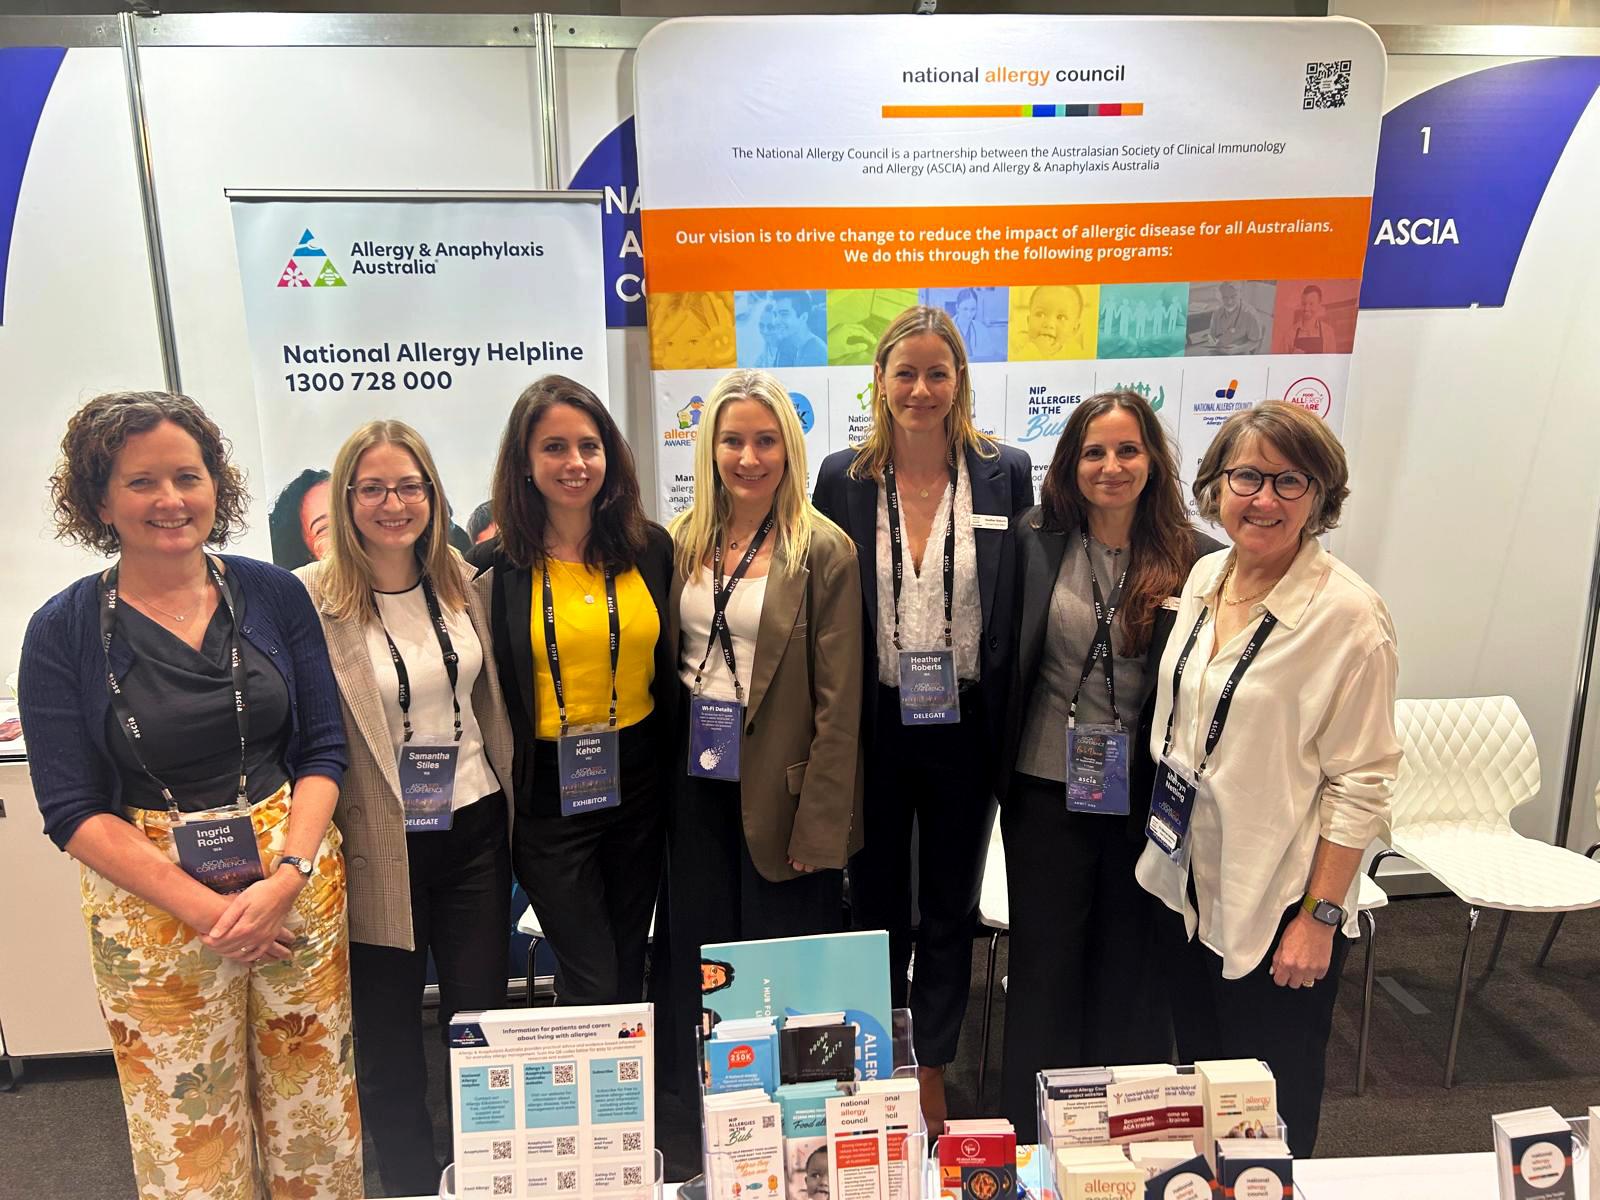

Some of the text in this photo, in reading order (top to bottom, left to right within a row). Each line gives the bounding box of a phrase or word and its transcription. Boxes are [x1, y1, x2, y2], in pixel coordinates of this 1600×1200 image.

[902, 65, 1125, 86] national allergy council
[1420, 126, 1431, 154] 1
[732, 141, 1286, 162] The National Allergy Council is a partnership between the Australasian Society of Clinical Immunology
[862, 159, 1160, 176] and Allergy (ASCIA) and Allergy & Anaphylaxis Australia
[675, 219, 1334, 245] Our vision is to drive change to reduce the impact of allergic disease for all Australians.
[1373, 218, 1460, 245] ASCIA
[618, 230, 644, 258] A
[350, 241, 544, 260] Allergy & Anaphylaxis
[844, 245, 1173, 265] We do this through the following programs:
[615, 274, 646, 303] C
[283, 341, 584, 366] National Allergy Helpline
[285, 370, 452, 392] 1300 728 000
[1029, 386, 1046, 395] NIP
[1028, 396, 1081, 405] ALLERGIES
[1028, 406, 1061, 415] IN THE
[1193, 402, 1215, 411] NATIONAL
[910, 656, 941, 664] Heather
[576, 738, 600, 747] Jillian
[408, 752, 450, 761] Samantha
[575, 746, 602, 756] Kehoe
[416, 761, 440, 769] Stiles
[1078, 776, 1097, 784] ascia
[572, 796, 607, 807] EXHIBITOR
[196, 826, 231, 838] Ingrid
[197, 835, 234, 847] Roche
[502, 1027, 540, 1035] Information
[551, 1024, 577, 1032] patients
[537, 1033, 554, 1041] living
[571, 1031, 597, 1039] allergies
[809, 1031, 828, 1056] YOUNG
[821, 1040, 842, 1065] ADULTS
[840, 1099, 870, 1108] national
[1245, 1096, 1271, 1105] allergy
[840, 1108, 866, 1117] allergy
[792, 1119, 815, 1130] Food
[841, 1117, 868, 1126] council
[724, 1128, 753, 1146] Bub
[1084, 1178, 1136, 1200] allergy
